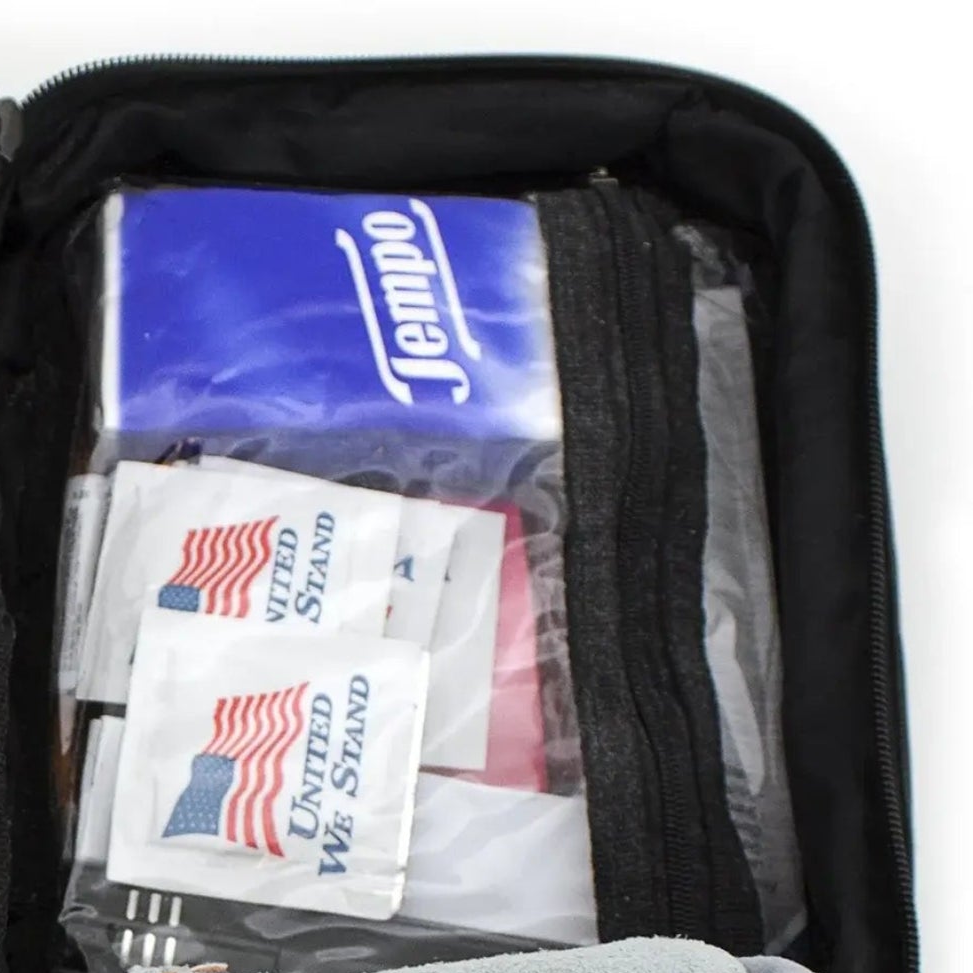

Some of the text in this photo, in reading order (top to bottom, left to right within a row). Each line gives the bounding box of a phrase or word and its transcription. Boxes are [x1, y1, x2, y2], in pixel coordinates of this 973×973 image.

[265, 527, 299, 623] NITED
[294, 510, 336, 625] STAND
[287, 692, 333, 841] UNITED
[317, 674, 370, 877] WE STAND
